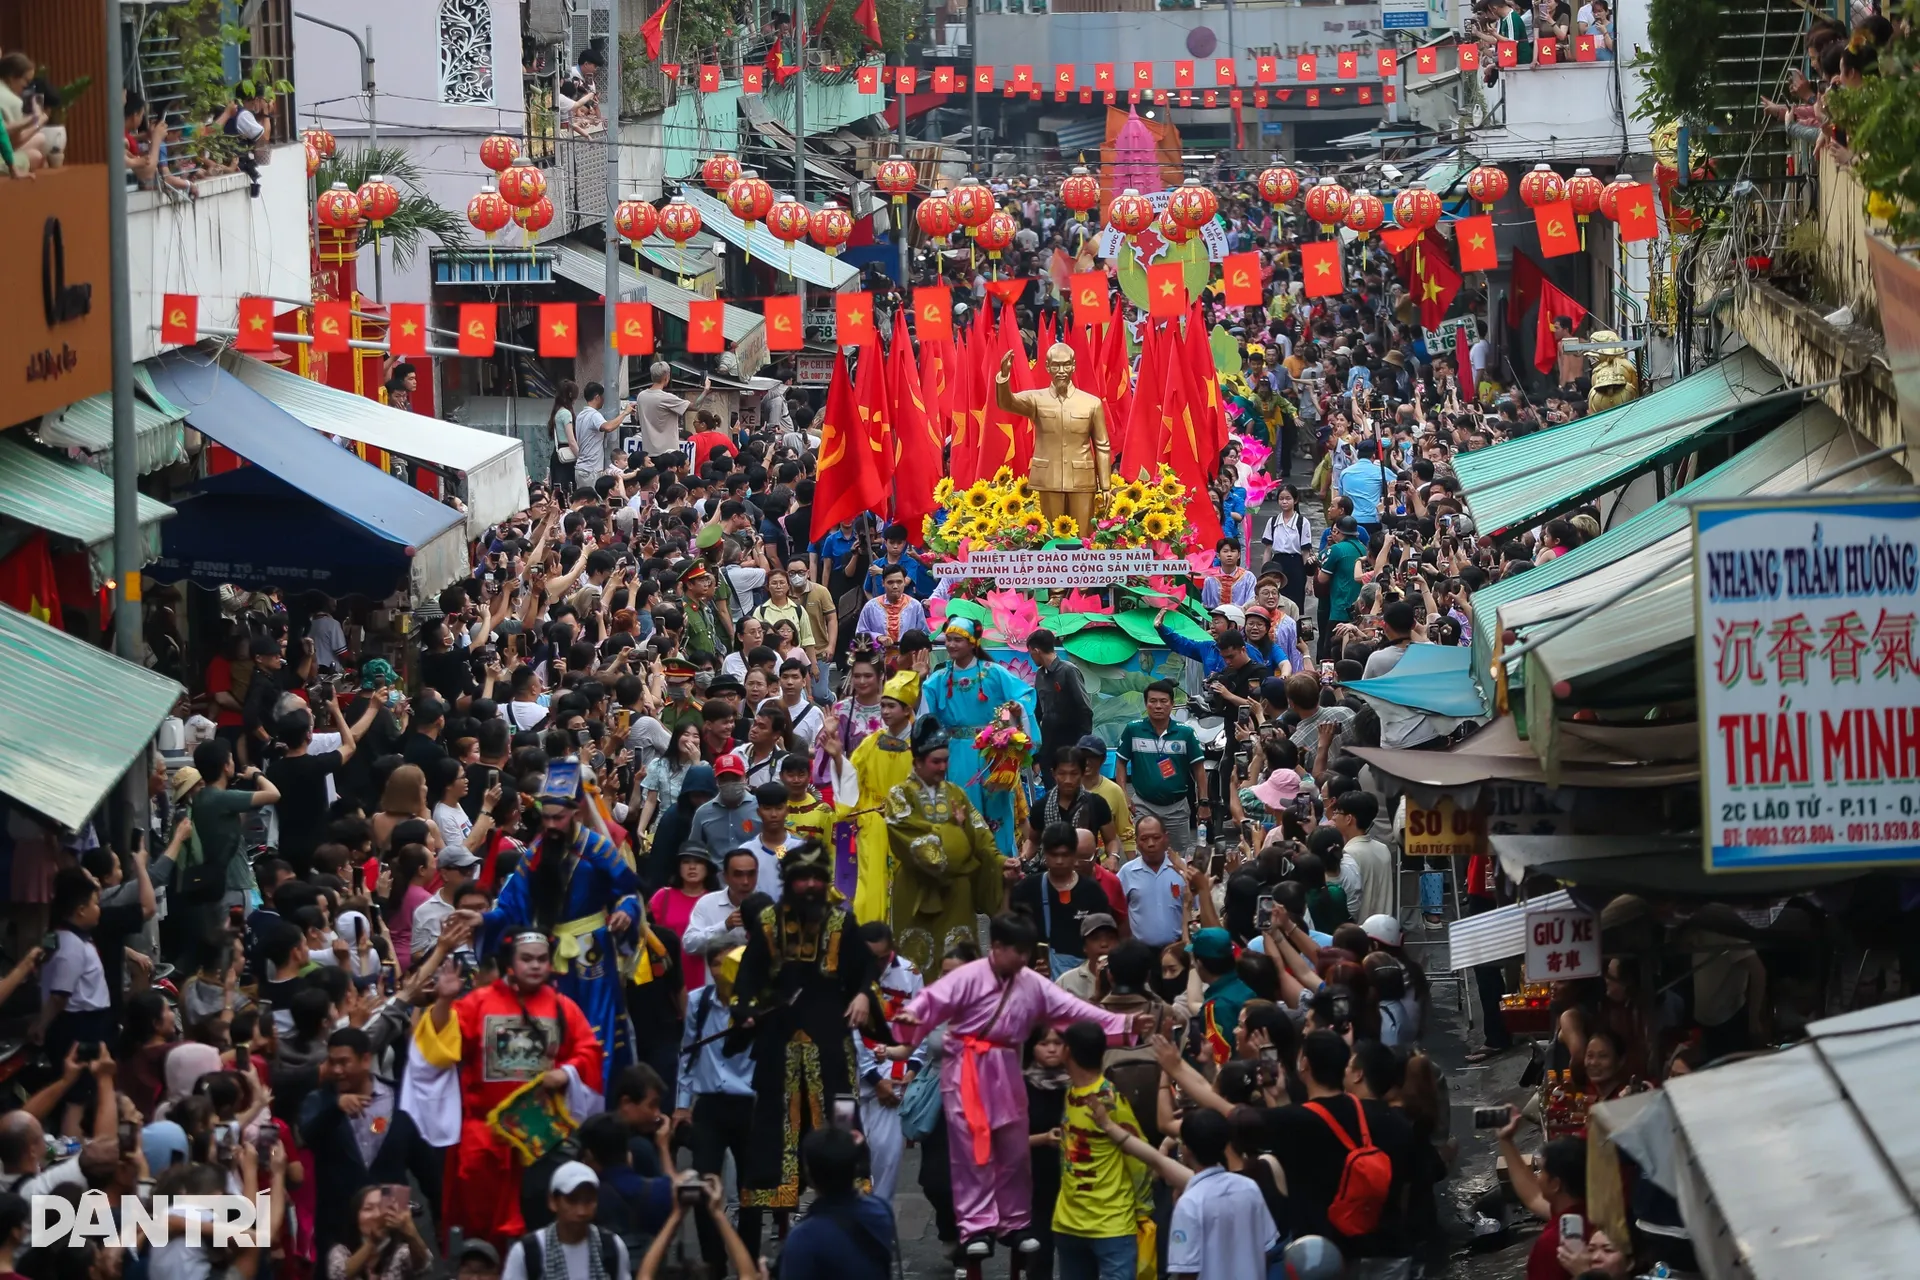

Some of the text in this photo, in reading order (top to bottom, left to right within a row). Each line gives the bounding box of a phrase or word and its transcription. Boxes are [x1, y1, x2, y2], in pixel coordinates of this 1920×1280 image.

[1246, 42, 1282, 60] NHÀ
[1287, 40, 1321, 59] HÁT
[936, 561, 1187, 575] NGÀY THÀNH LẬP ĐẢNG CỘNG SẢN VIỆT NAM
[971, 550, 1151, 565] NHIỆT LIỆT CHÀO MỪNG 95 NĂM
[1707, 547, 1781, 600] NHANG
[1845, 535, 1918, 595] HƯƠNG
[999, 576, 1057, 586] 03/02/1930
[1066, 575, 1125, 585] 03/02/2025
[1718, 694, 1920, 787] THÁI MINH
[1722, 802, 1747, 822] 2C
[1752, 797, 1790, 820] LÃO
[1796, 793, 1821, 819] TỬ
[1840, 796, 1877, 817] P.11
[1900, 794, 1920, 817] Q.
[1847, 820, 1920, 843] 0913.939.8
[1533, 916, 1593, 946] GIỮ XE
